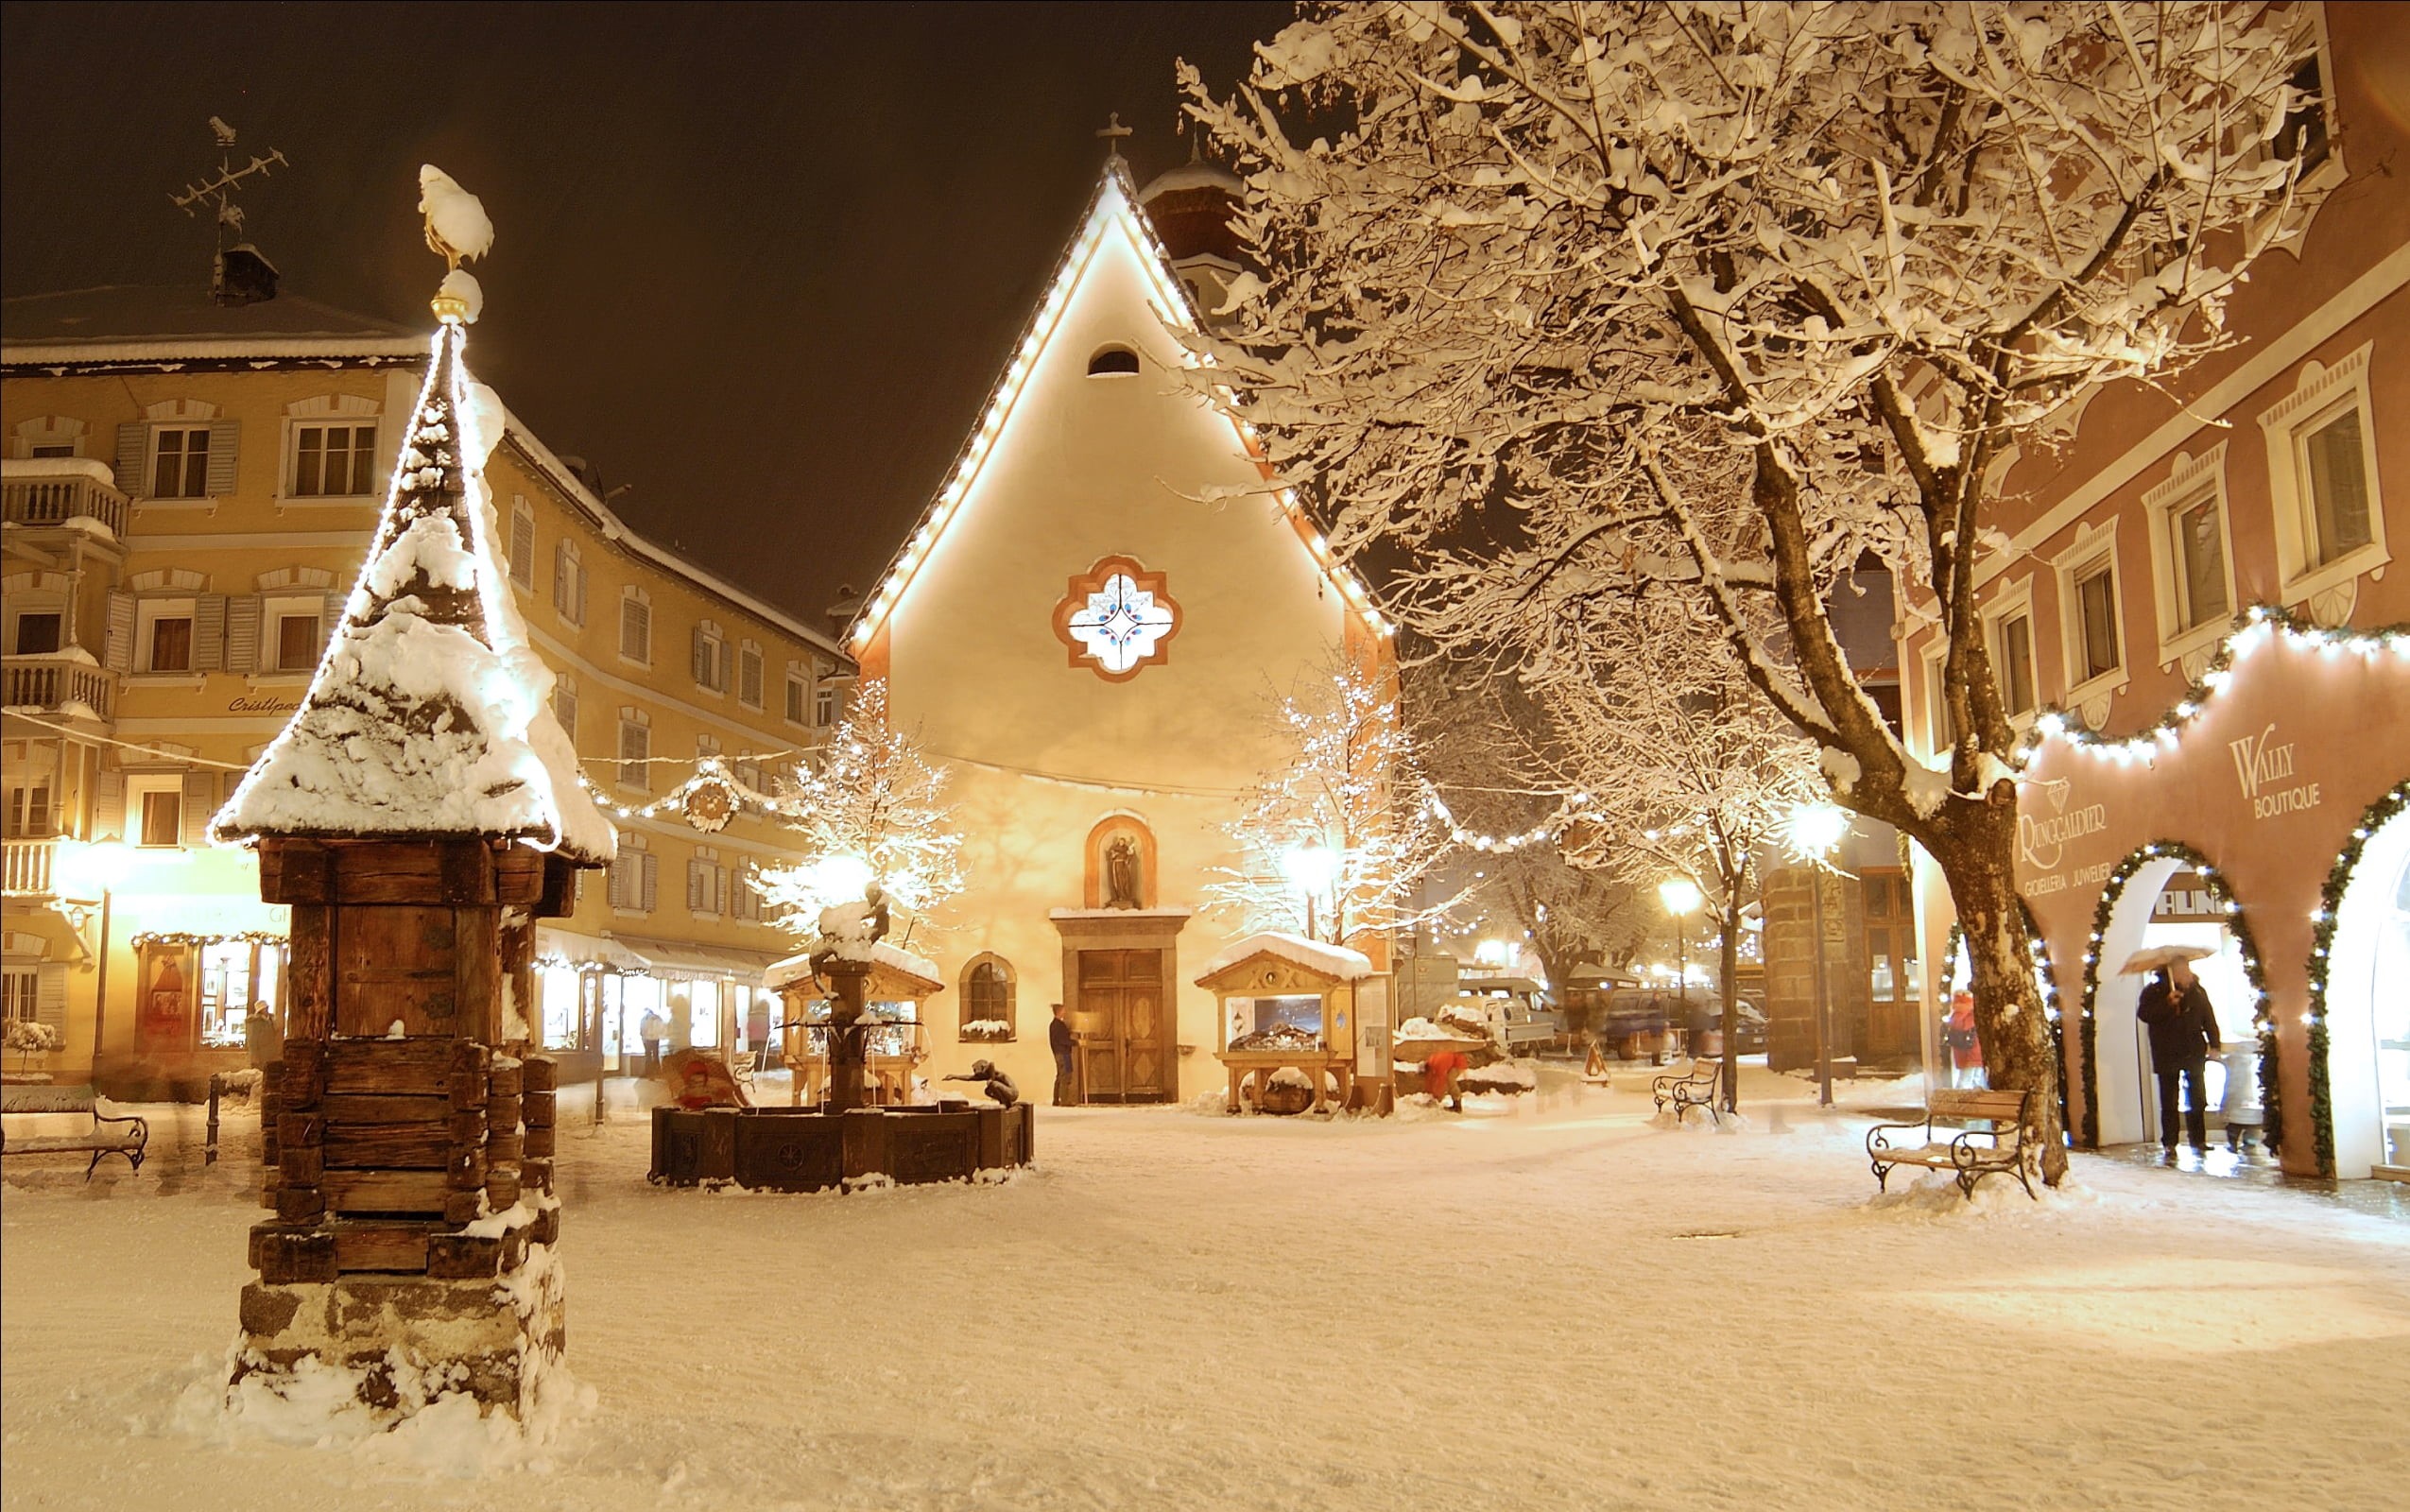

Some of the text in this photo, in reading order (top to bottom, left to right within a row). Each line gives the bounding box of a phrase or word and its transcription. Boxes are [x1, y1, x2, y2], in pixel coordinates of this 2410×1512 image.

[2228, 723, 2295, 799] WALLY
[2254, 782, 2320, 819] BOUTIQUE
[2020, 803, 2107, 869] RUNGGALDIER
[2024, 862, 2110, 897] GIOIELLERIA JUWELIER
